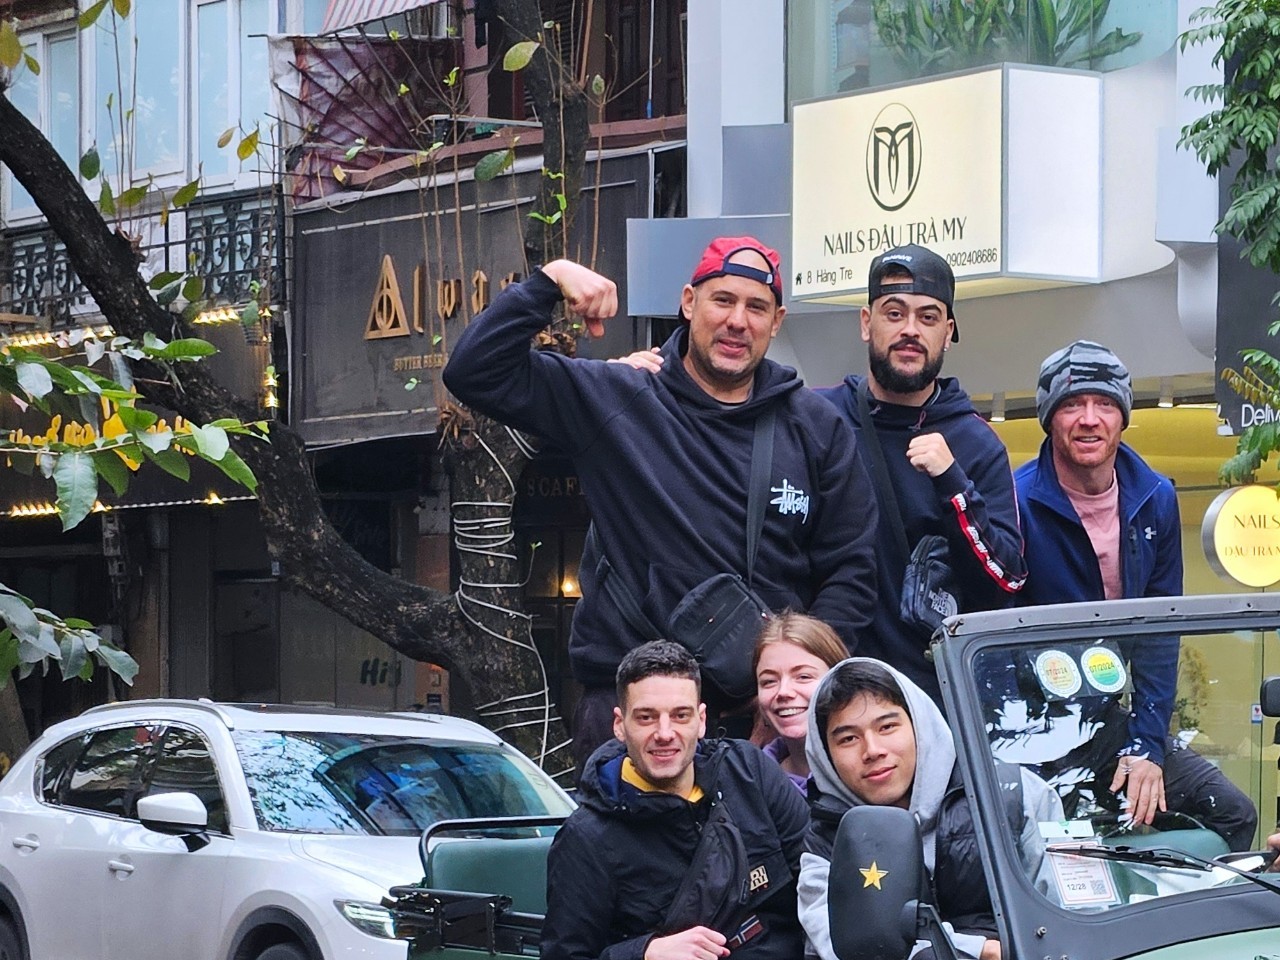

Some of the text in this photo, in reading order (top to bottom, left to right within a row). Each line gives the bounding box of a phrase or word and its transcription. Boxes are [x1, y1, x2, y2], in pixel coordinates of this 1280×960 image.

[824, 216, 967, 256] NAILS ĐẬU TRÀ MY
[946, 249, 997, 267] 0902408686
[806, 267, 853, 285] 8 Hàng Tre
[1233, 514, 1280, 530] NAILS
[1089, 661, 1115, 673] 07/2024
[1067, 883, 1087, 891] 12/28
